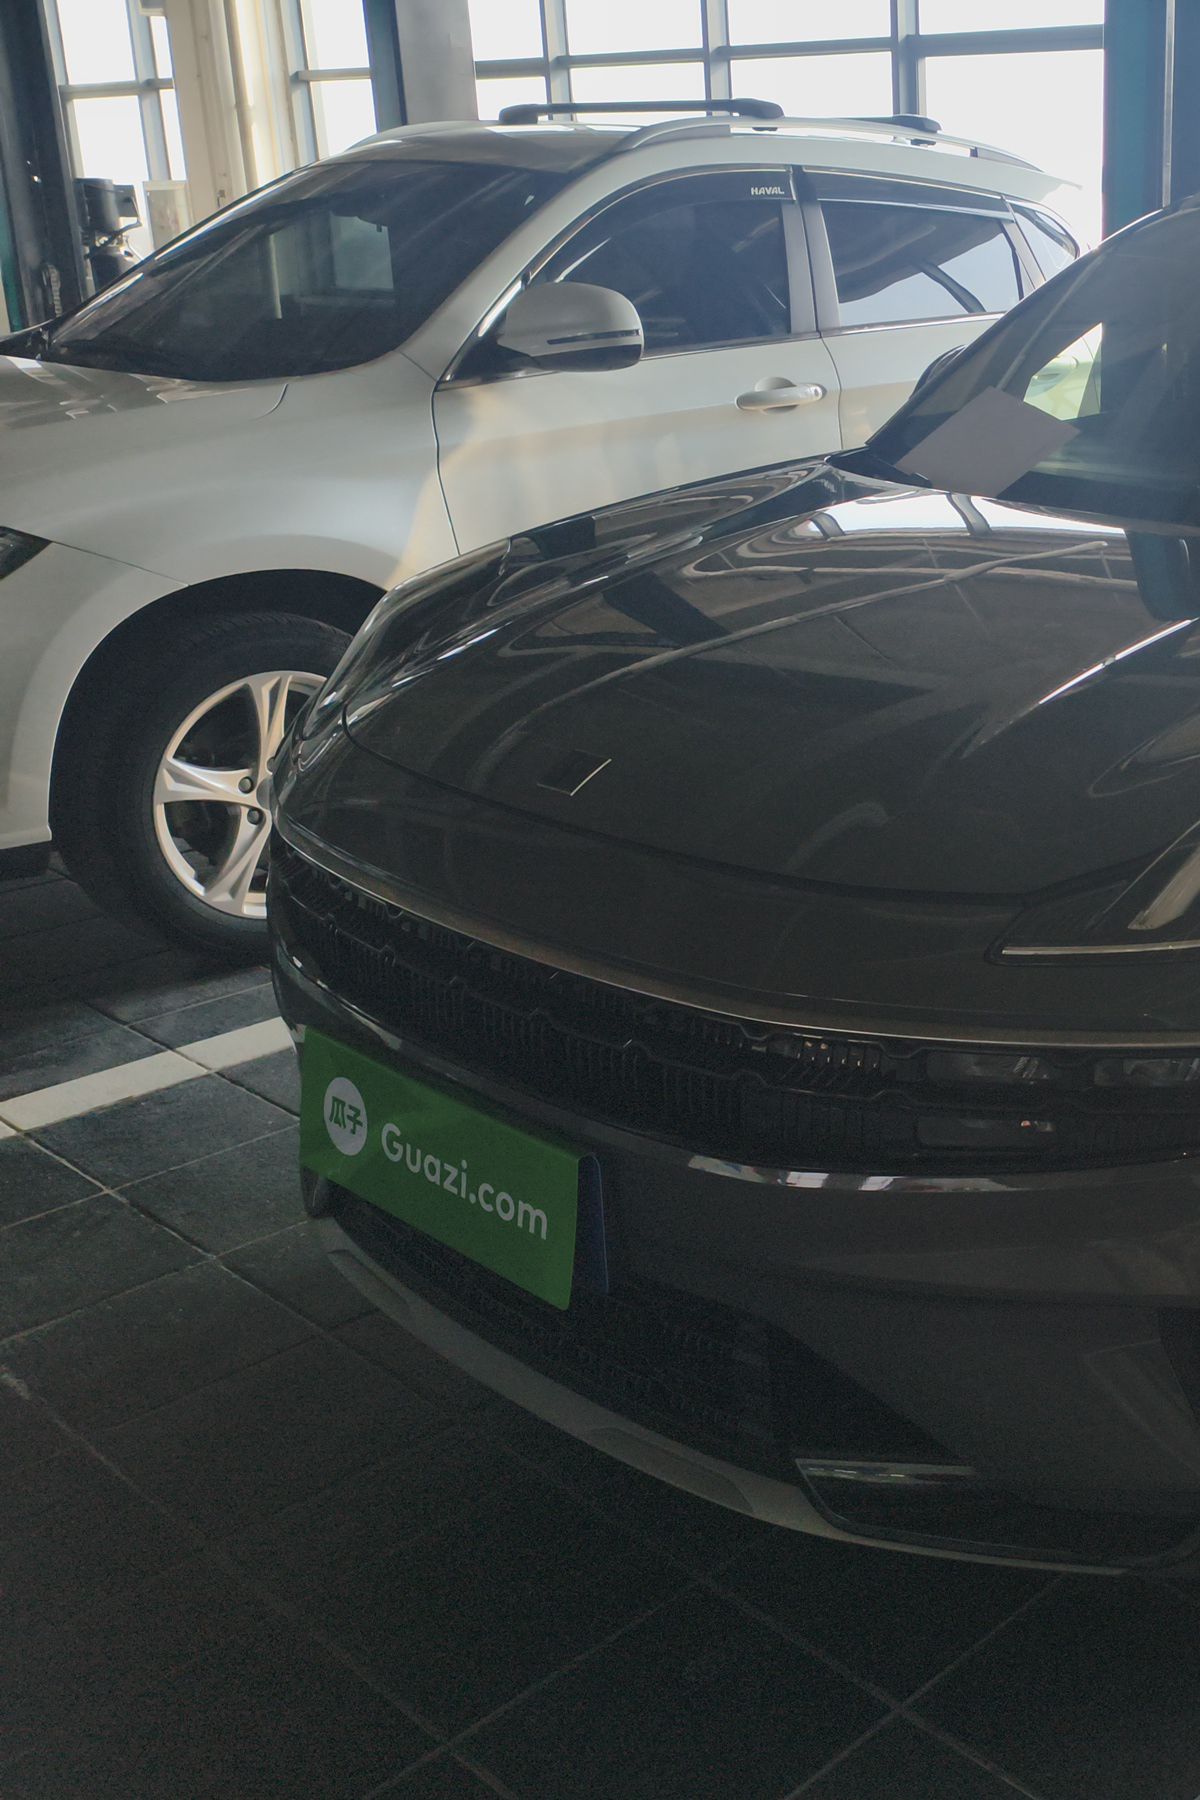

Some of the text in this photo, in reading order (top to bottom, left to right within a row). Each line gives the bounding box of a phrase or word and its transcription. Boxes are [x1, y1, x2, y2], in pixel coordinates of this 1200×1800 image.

[751, 187, 785, 195] HAVAL
[329, 1095, 364, 1135] 瓜子
[381, 1122, 548, 1240] Guazi.com
